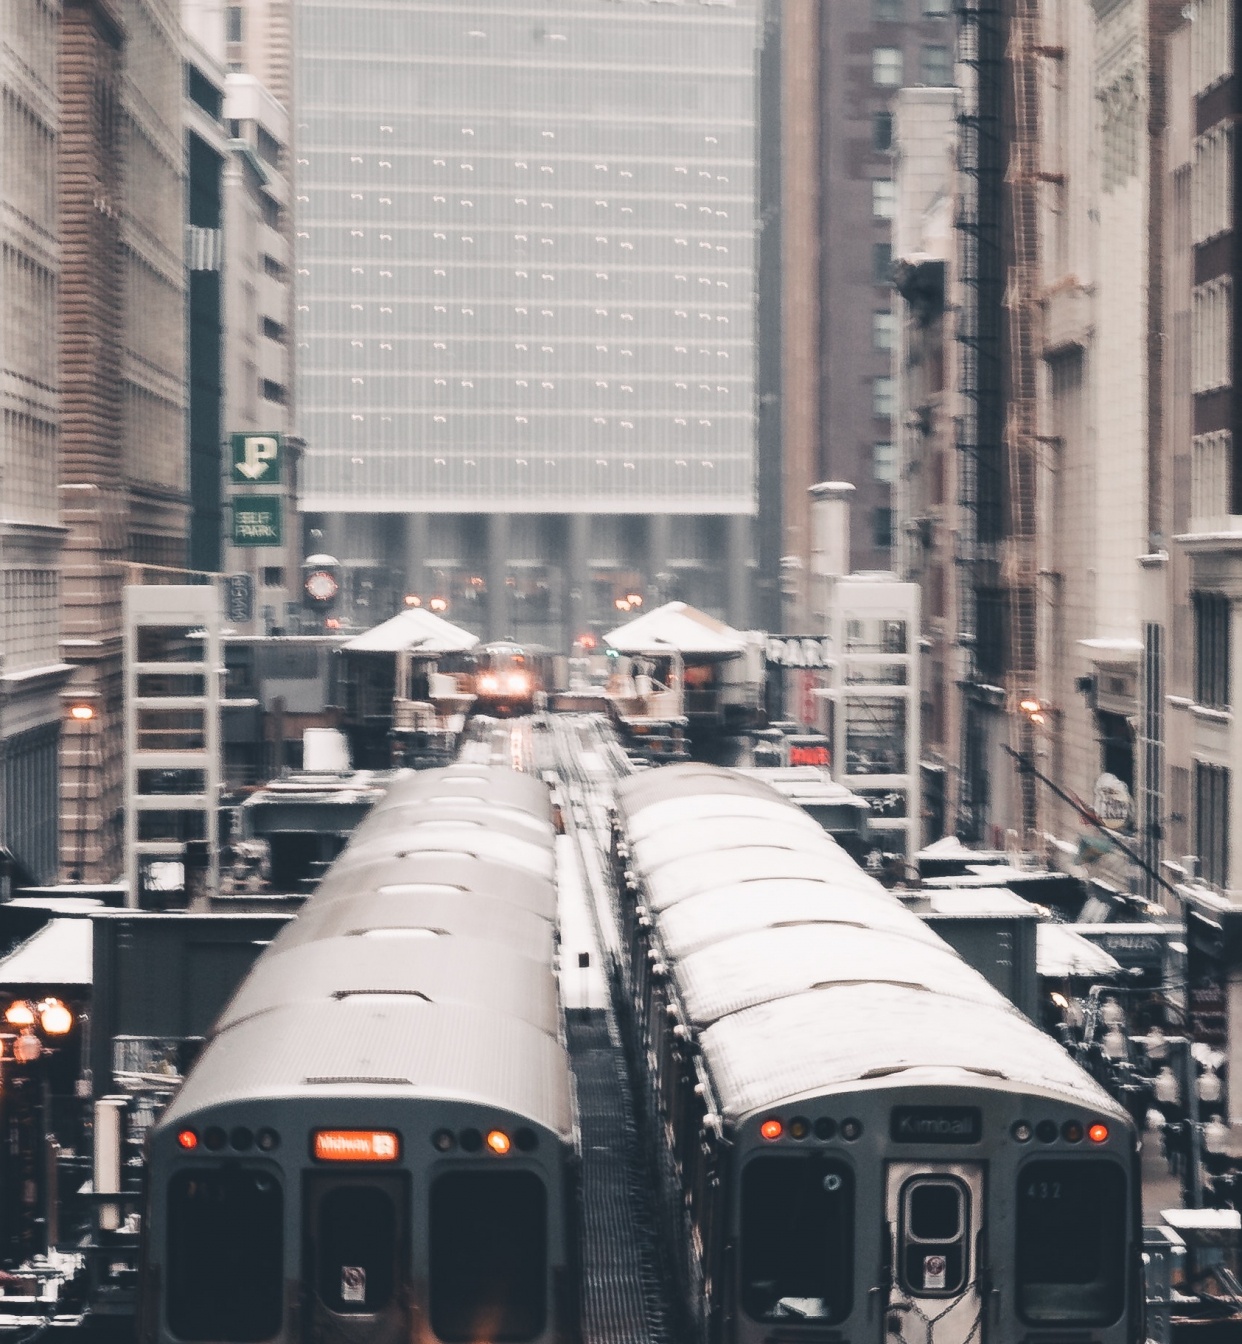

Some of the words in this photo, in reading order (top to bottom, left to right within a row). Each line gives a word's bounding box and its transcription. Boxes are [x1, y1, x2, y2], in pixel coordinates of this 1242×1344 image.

[236, 437, 278, 480] P
[235, 511, 271, 524] SELF
[235, 525, 277, 538] PARK
[901, 1115, 972, 1133] Kimball
[317, 1134, 370, 1154] Midway
